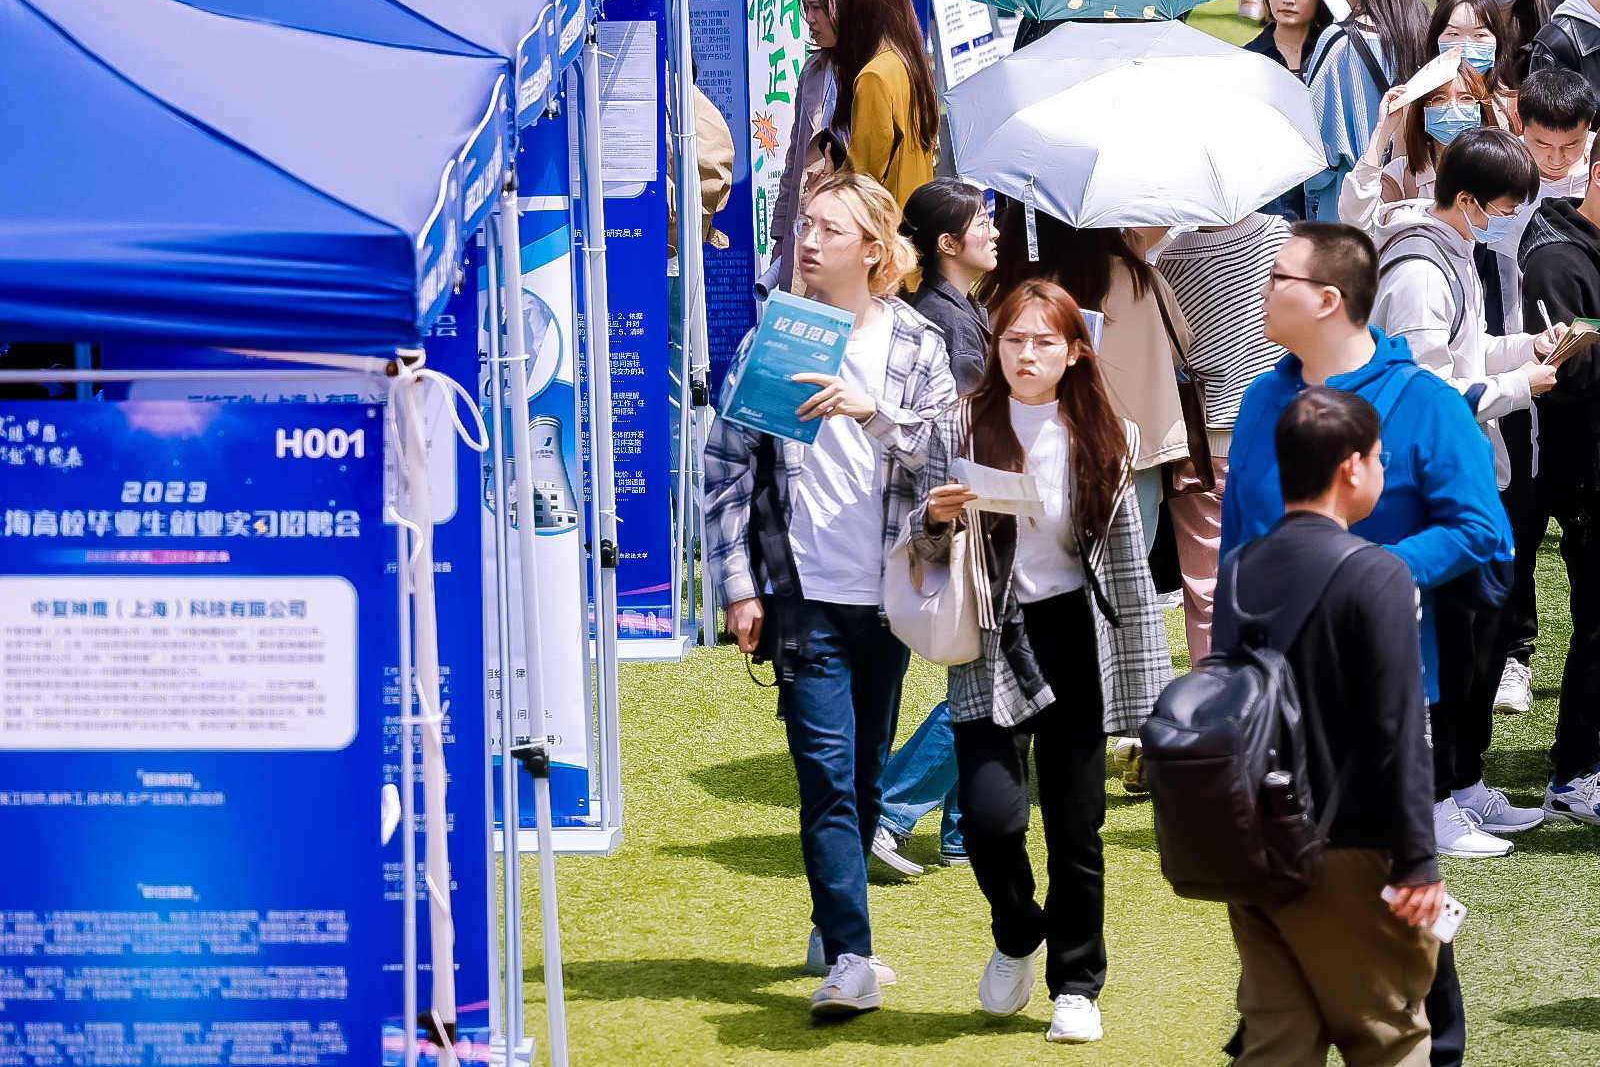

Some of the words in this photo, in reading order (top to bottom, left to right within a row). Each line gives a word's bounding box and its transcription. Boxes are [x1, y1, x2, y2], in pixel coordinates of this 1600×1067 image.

[773, 316, 840, 347] 校园招聘
[275, 429, 365, 459] H001
[121, 481, 207, 504] 2023
[0, 509, 361, 539] 海高校毕业生就业实习招聘会
